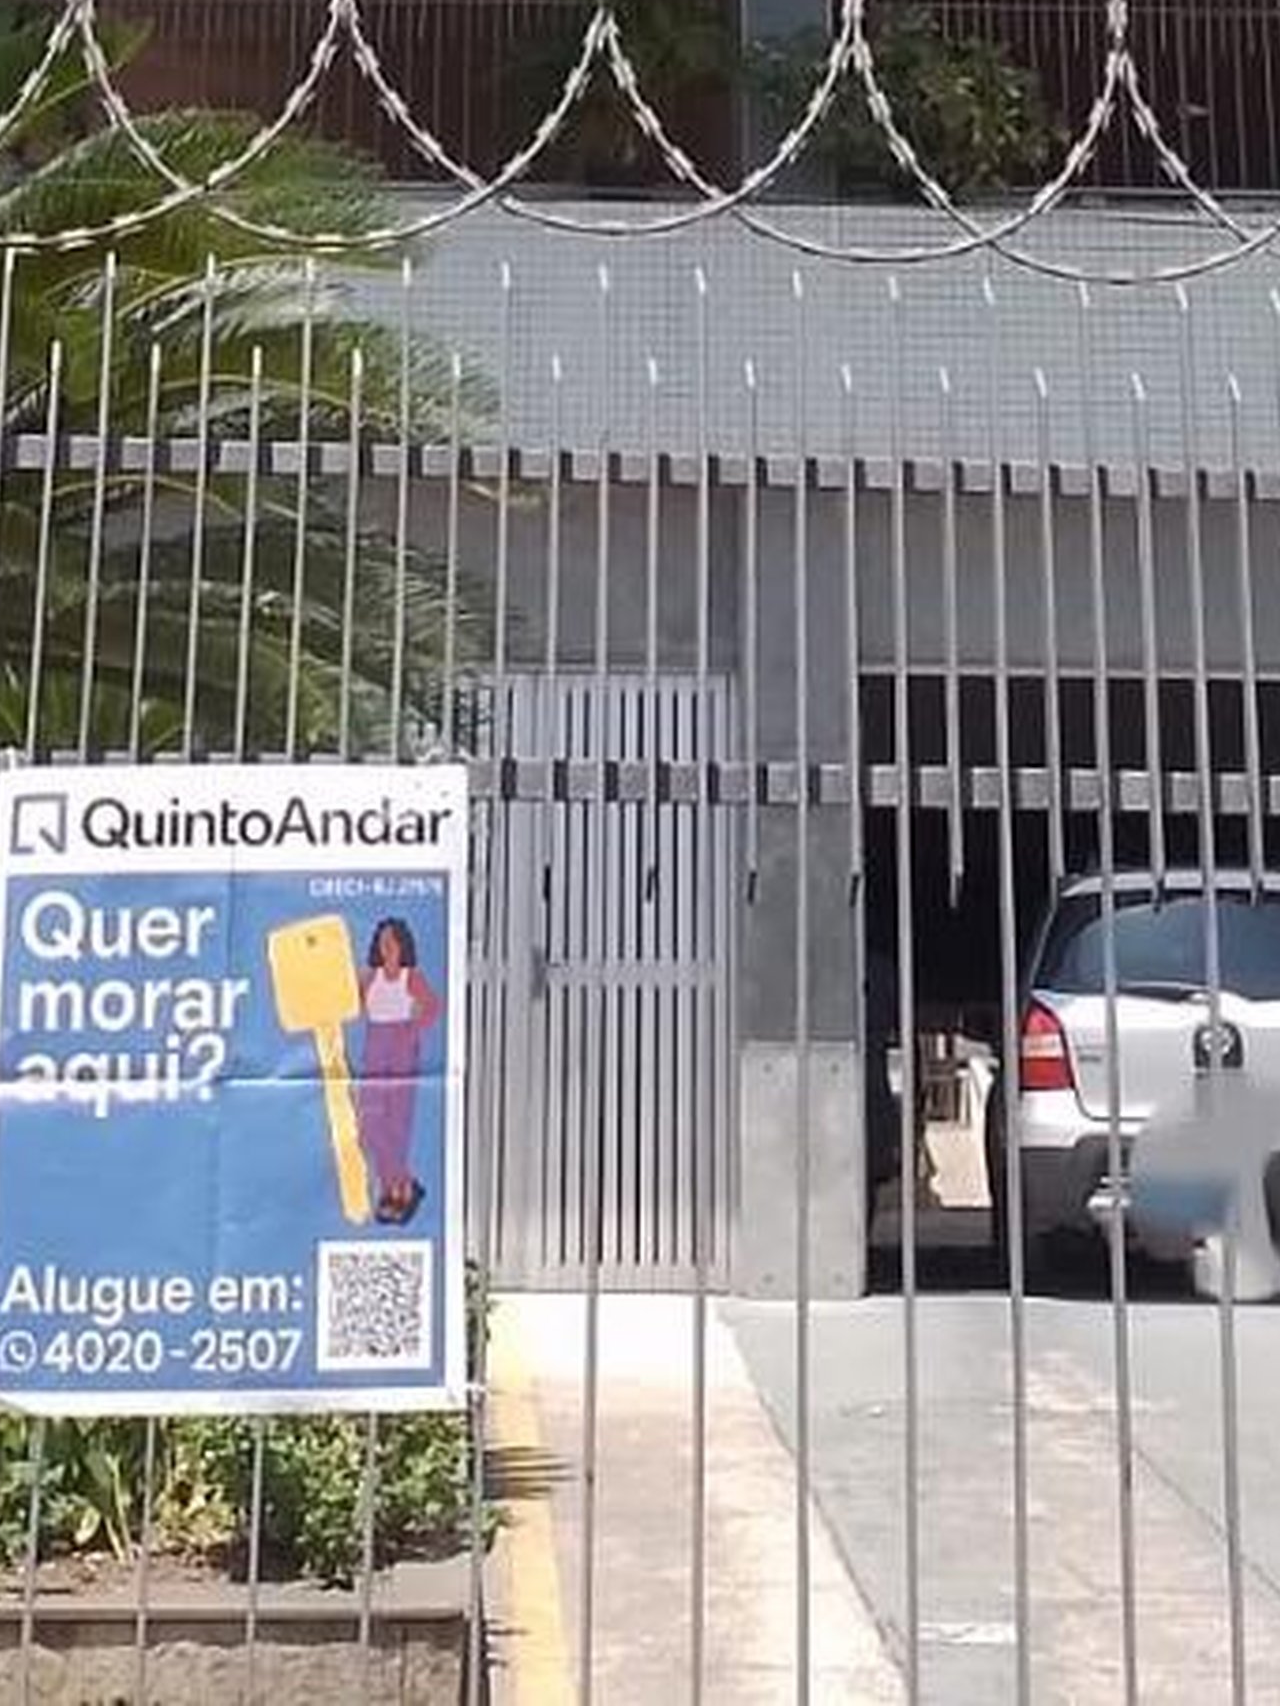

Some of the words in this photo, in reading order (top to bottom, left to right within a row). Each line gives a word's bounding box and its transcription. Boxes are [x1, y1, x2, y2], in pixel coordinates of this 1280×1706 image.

[81, 797, 452, 849] QuintoAndar
[22, 890, 214, 960] Quer
[20, 979, 249, 1031] morar
[18, 1034, 225, 1118] aqui?
[0, 1265, 194, 1325] Alugue
[209, 1275, 303, 1313] em:
